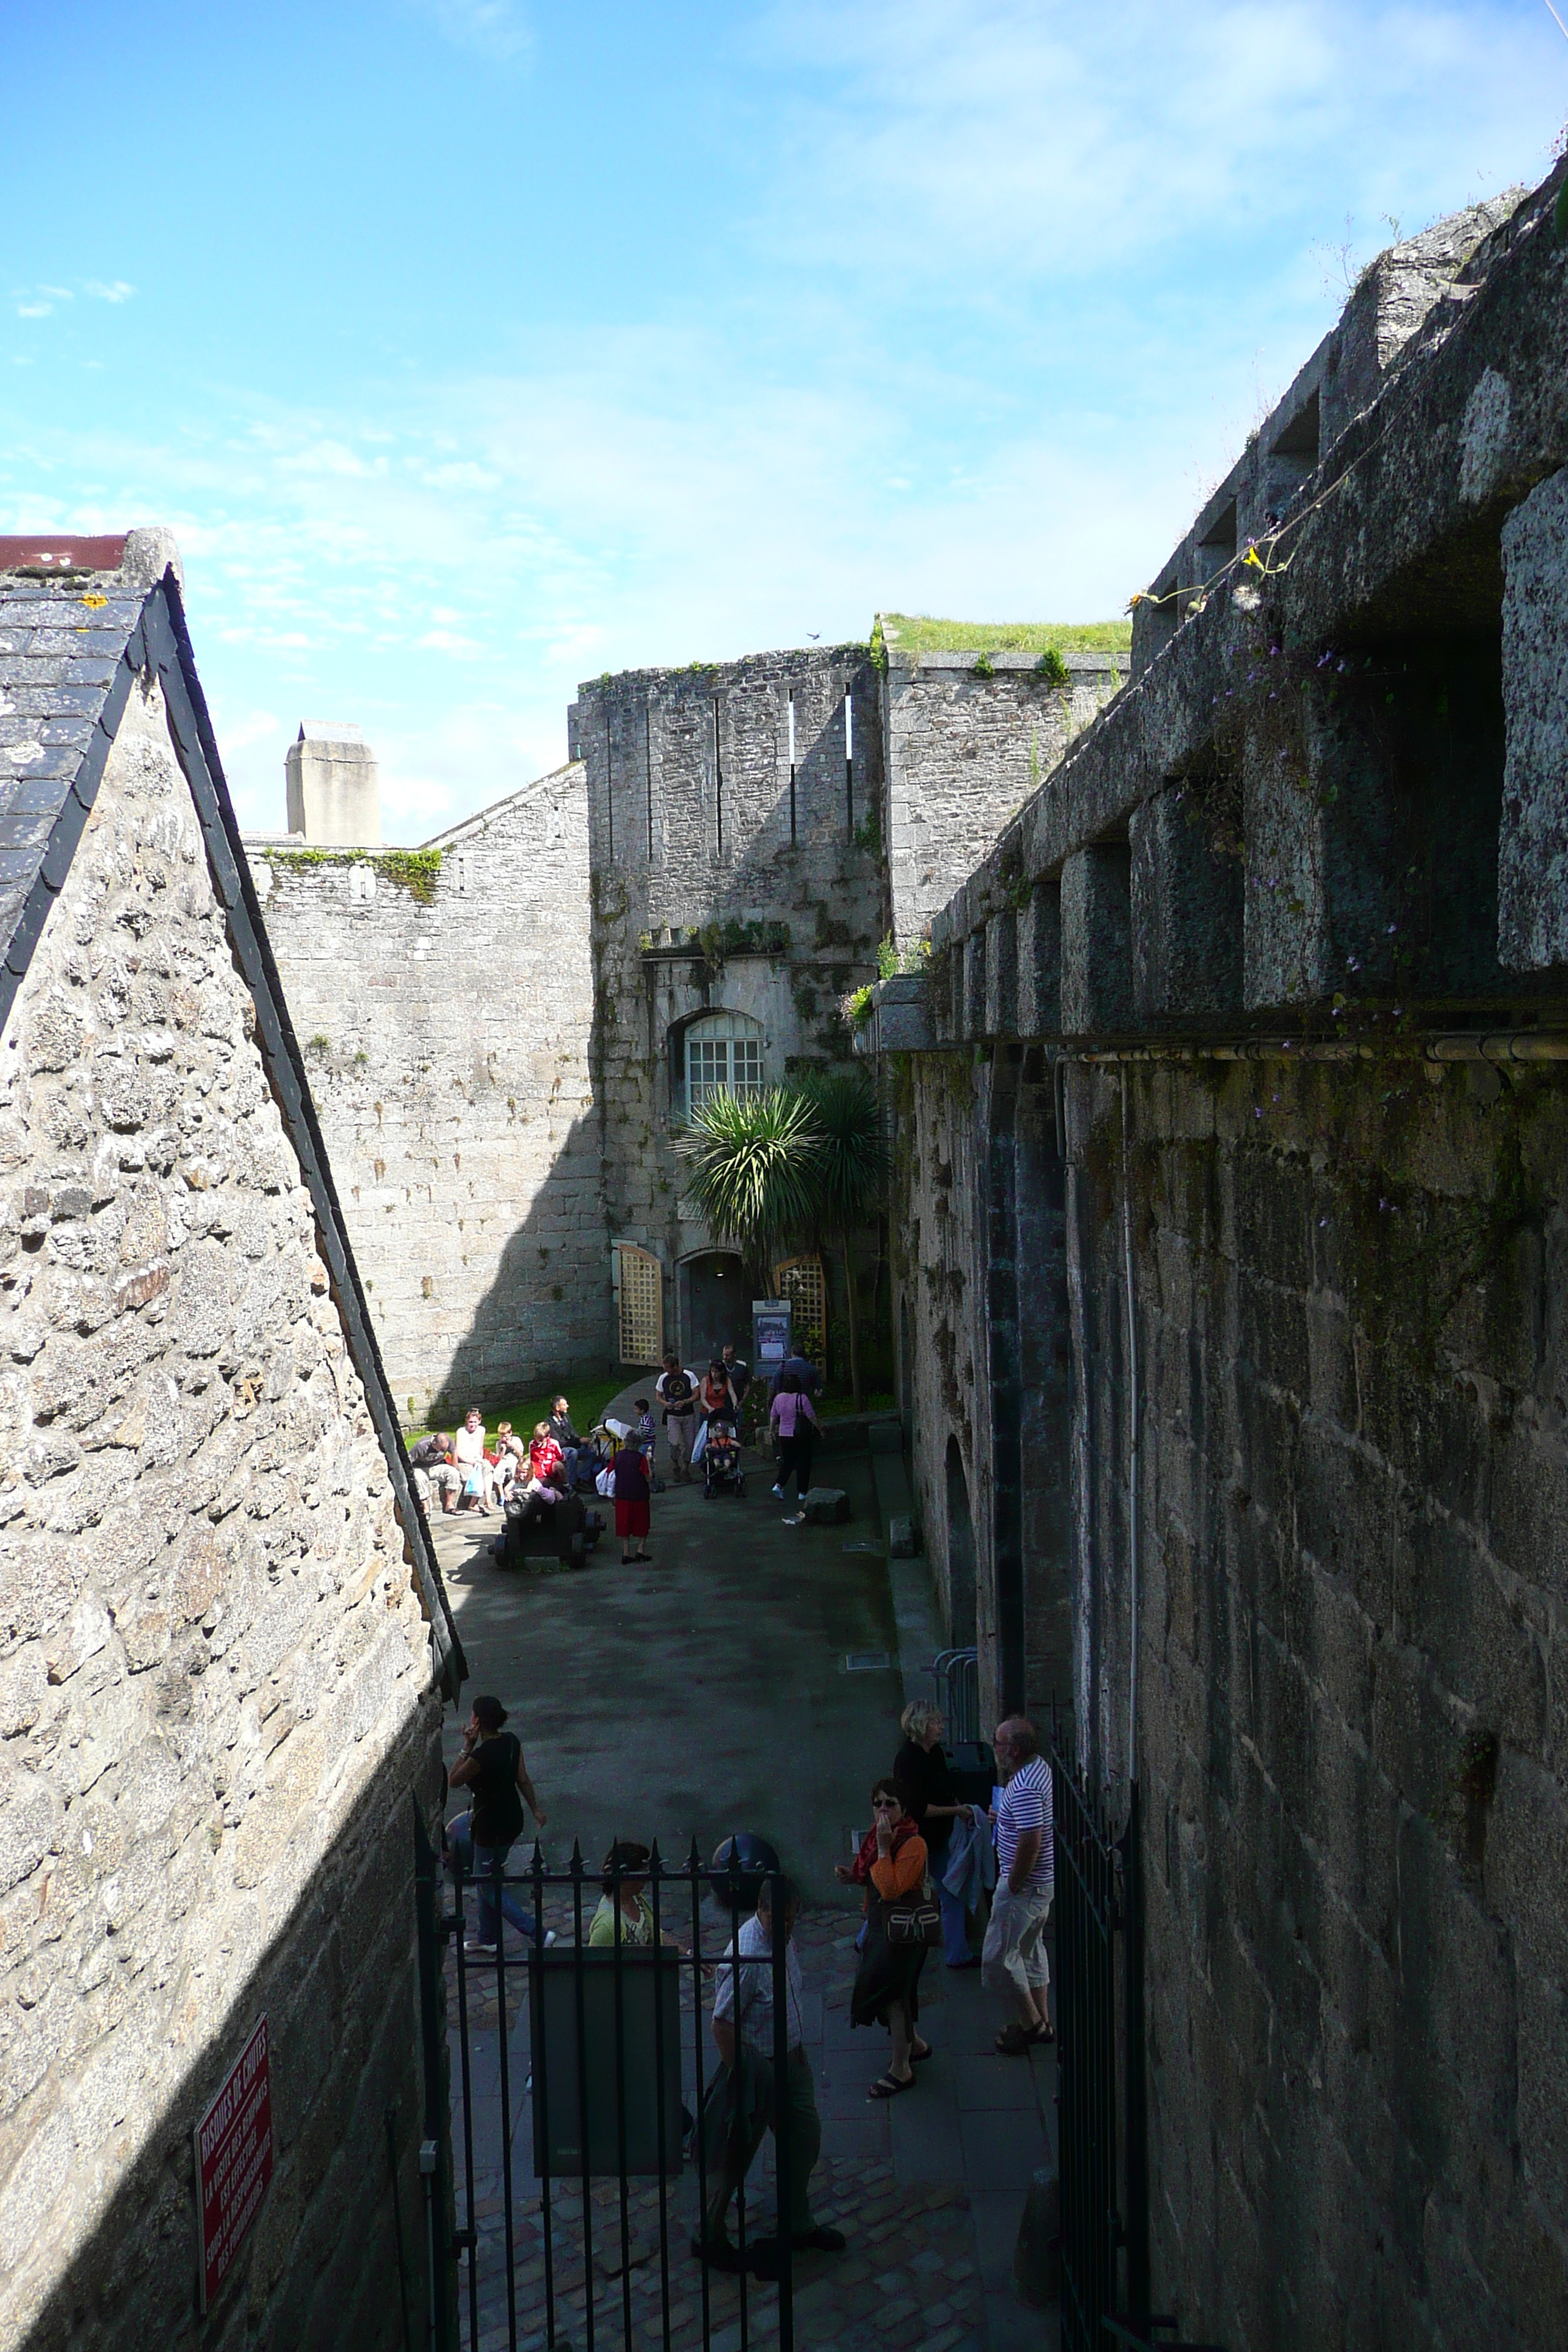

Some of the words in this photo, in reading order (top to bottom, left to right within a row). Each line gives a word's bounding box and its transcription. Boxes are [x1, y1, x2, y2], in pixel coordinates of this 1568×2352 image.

[202, 2087, 233, 2166] RISQUES
[233, 2069, 242, 2107] DE
[243, 2026, 266, 2089] CHUTES
[206, 2179, 213, 2208] LA
[214, 2145, 231, 2193] VISITE
[231, 2125, 242, 2158] DES
[242, 2076, 268, 2137] REMPARTS
[220, 2177, 230, 2211] EST
[206, 2225, 222, 2270] SOUS
[223, 2208, 230, 2236] LA
[218, 2242, 229, 2279] DES
